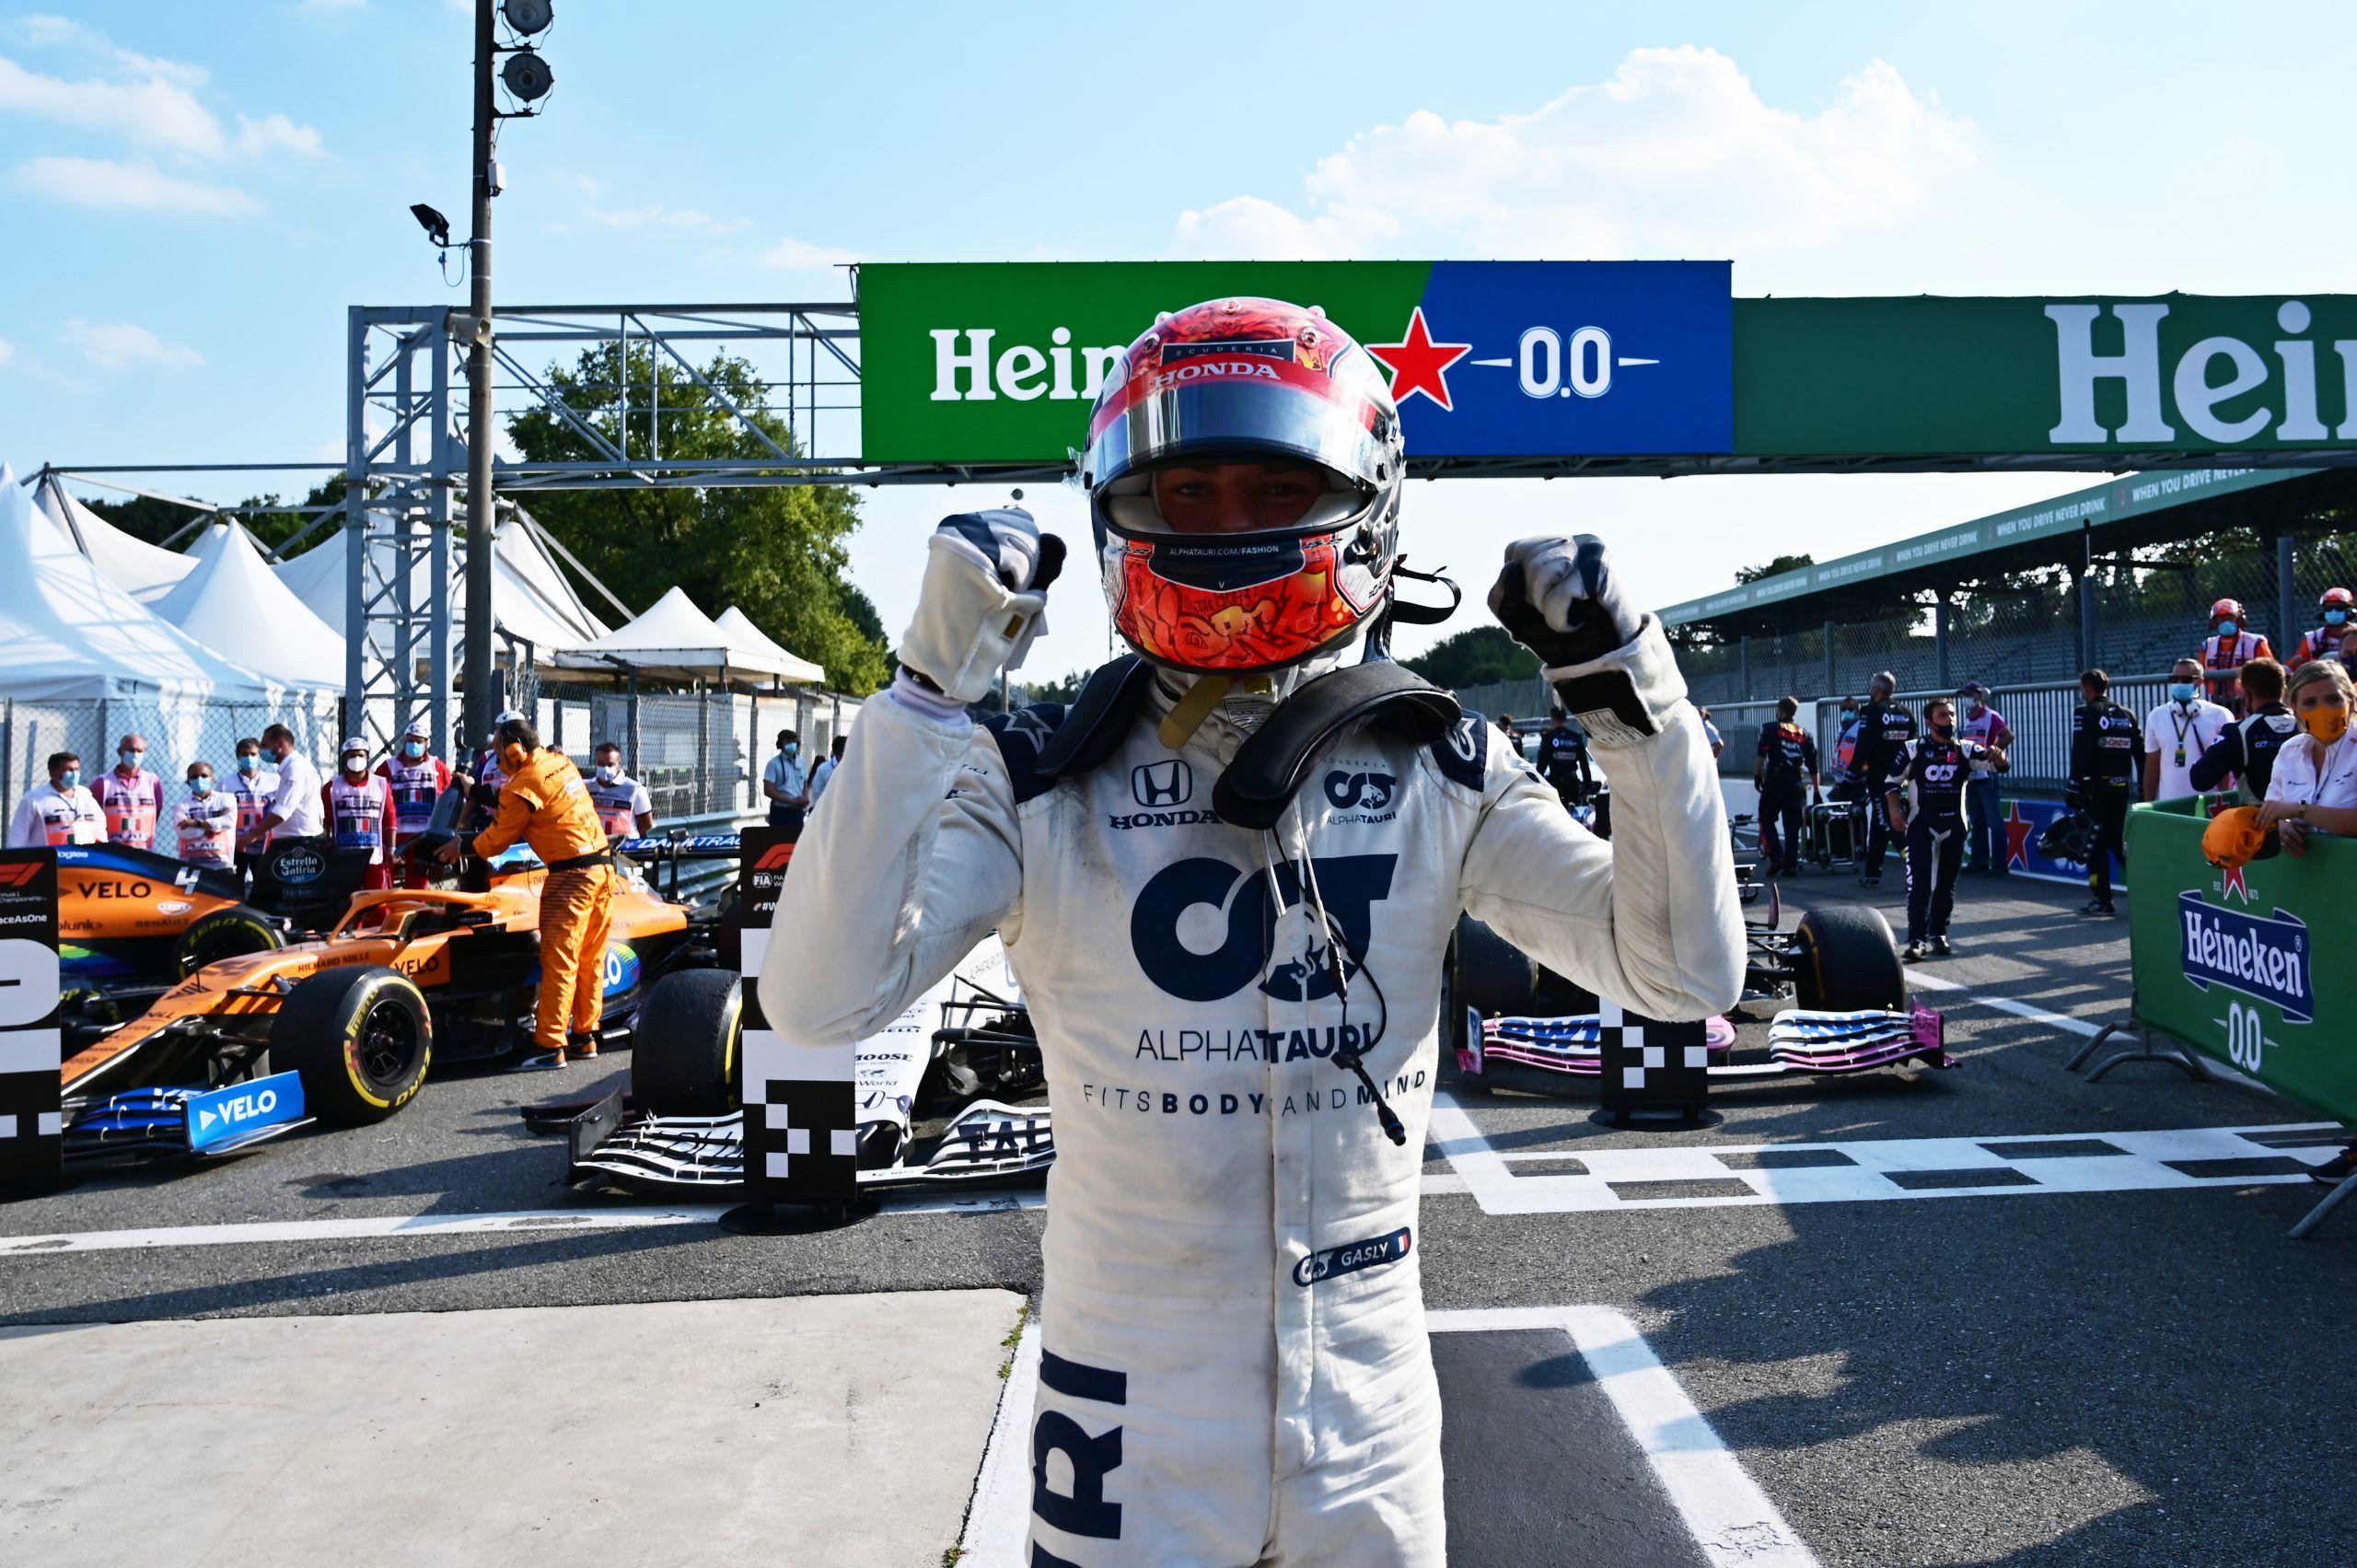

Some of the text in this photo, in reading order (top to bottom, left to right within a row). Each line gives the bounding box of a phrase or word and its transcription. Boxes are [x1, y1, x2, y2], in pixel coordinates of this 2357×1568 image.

[1175, 347, 1278, 356] SCUDERIA
[1154, 363, 1281, 388] HONDA
[2045, 300, 2357, 444] Hei
[2132, 482, 2158, 503] WHEN
[2161, 475, 2180, 495] YOU
[2182, 470, 2212, 490] DRIVE
[1997, 497, 2106, 537] WHEN YOU DRIVE NEVER DRINK
[1169, 545, 1280, 556] ALPHATAURI.COM/FASHION
[1109, 809, 1223, 830] HONDA
[1326, 811, 1397, 826] ALPHATAURI
[280, 858, 318, 867] Estrella
[77, 881, 152, 899] VELO
[174, 865, 201, 895] 4
[297, 951, 371, 973] RICHARD MILLE
[394, 956, 440, 977] VELO
[2185, 910, 2303, 998] Heineken
[1135, 1022, 1371, 1063] ALPHATAURI
[2228, 1000, 2262, 1073] 0.0
[217, 1089, 277, 1125] VELO
[1341, 1241, 1389, 1267] GASLY
